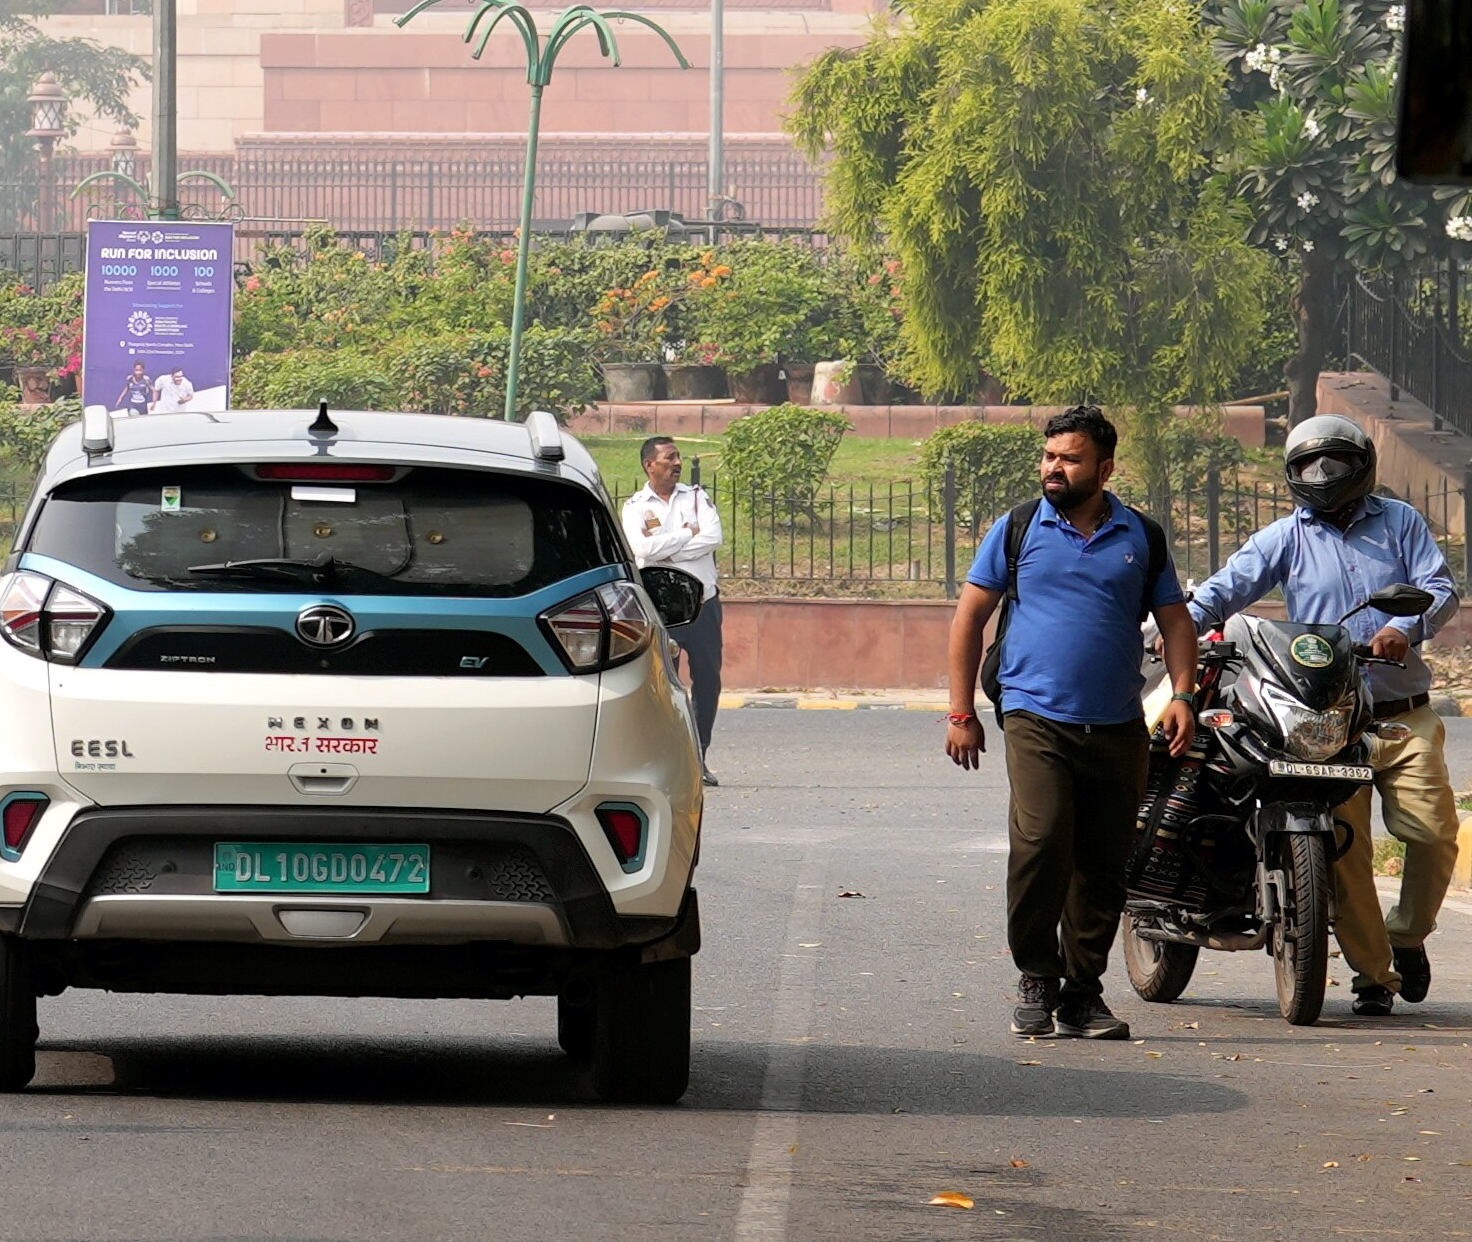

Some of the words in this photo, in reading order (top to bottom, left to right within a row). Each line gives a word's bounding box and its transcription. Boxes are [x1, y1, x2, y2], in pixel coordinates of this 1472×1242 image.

[100, 247, 126, 259] RUN
[128, 248, 153, 260] FOR
[154, 248, 218, 261] INCLUSION
[101, 264, 137, 276] 10000
[150, 265, 179, 277] 1000
[194, 266, 215, 277] 100
[160, 655, 215, 664] ZIPTRON
[459, 656, 490, 668] EV
[267, 716, 379, 731] NEXON
[71, 739, 134, 757] EESL
[316, 737, 379, 755] सरकार
